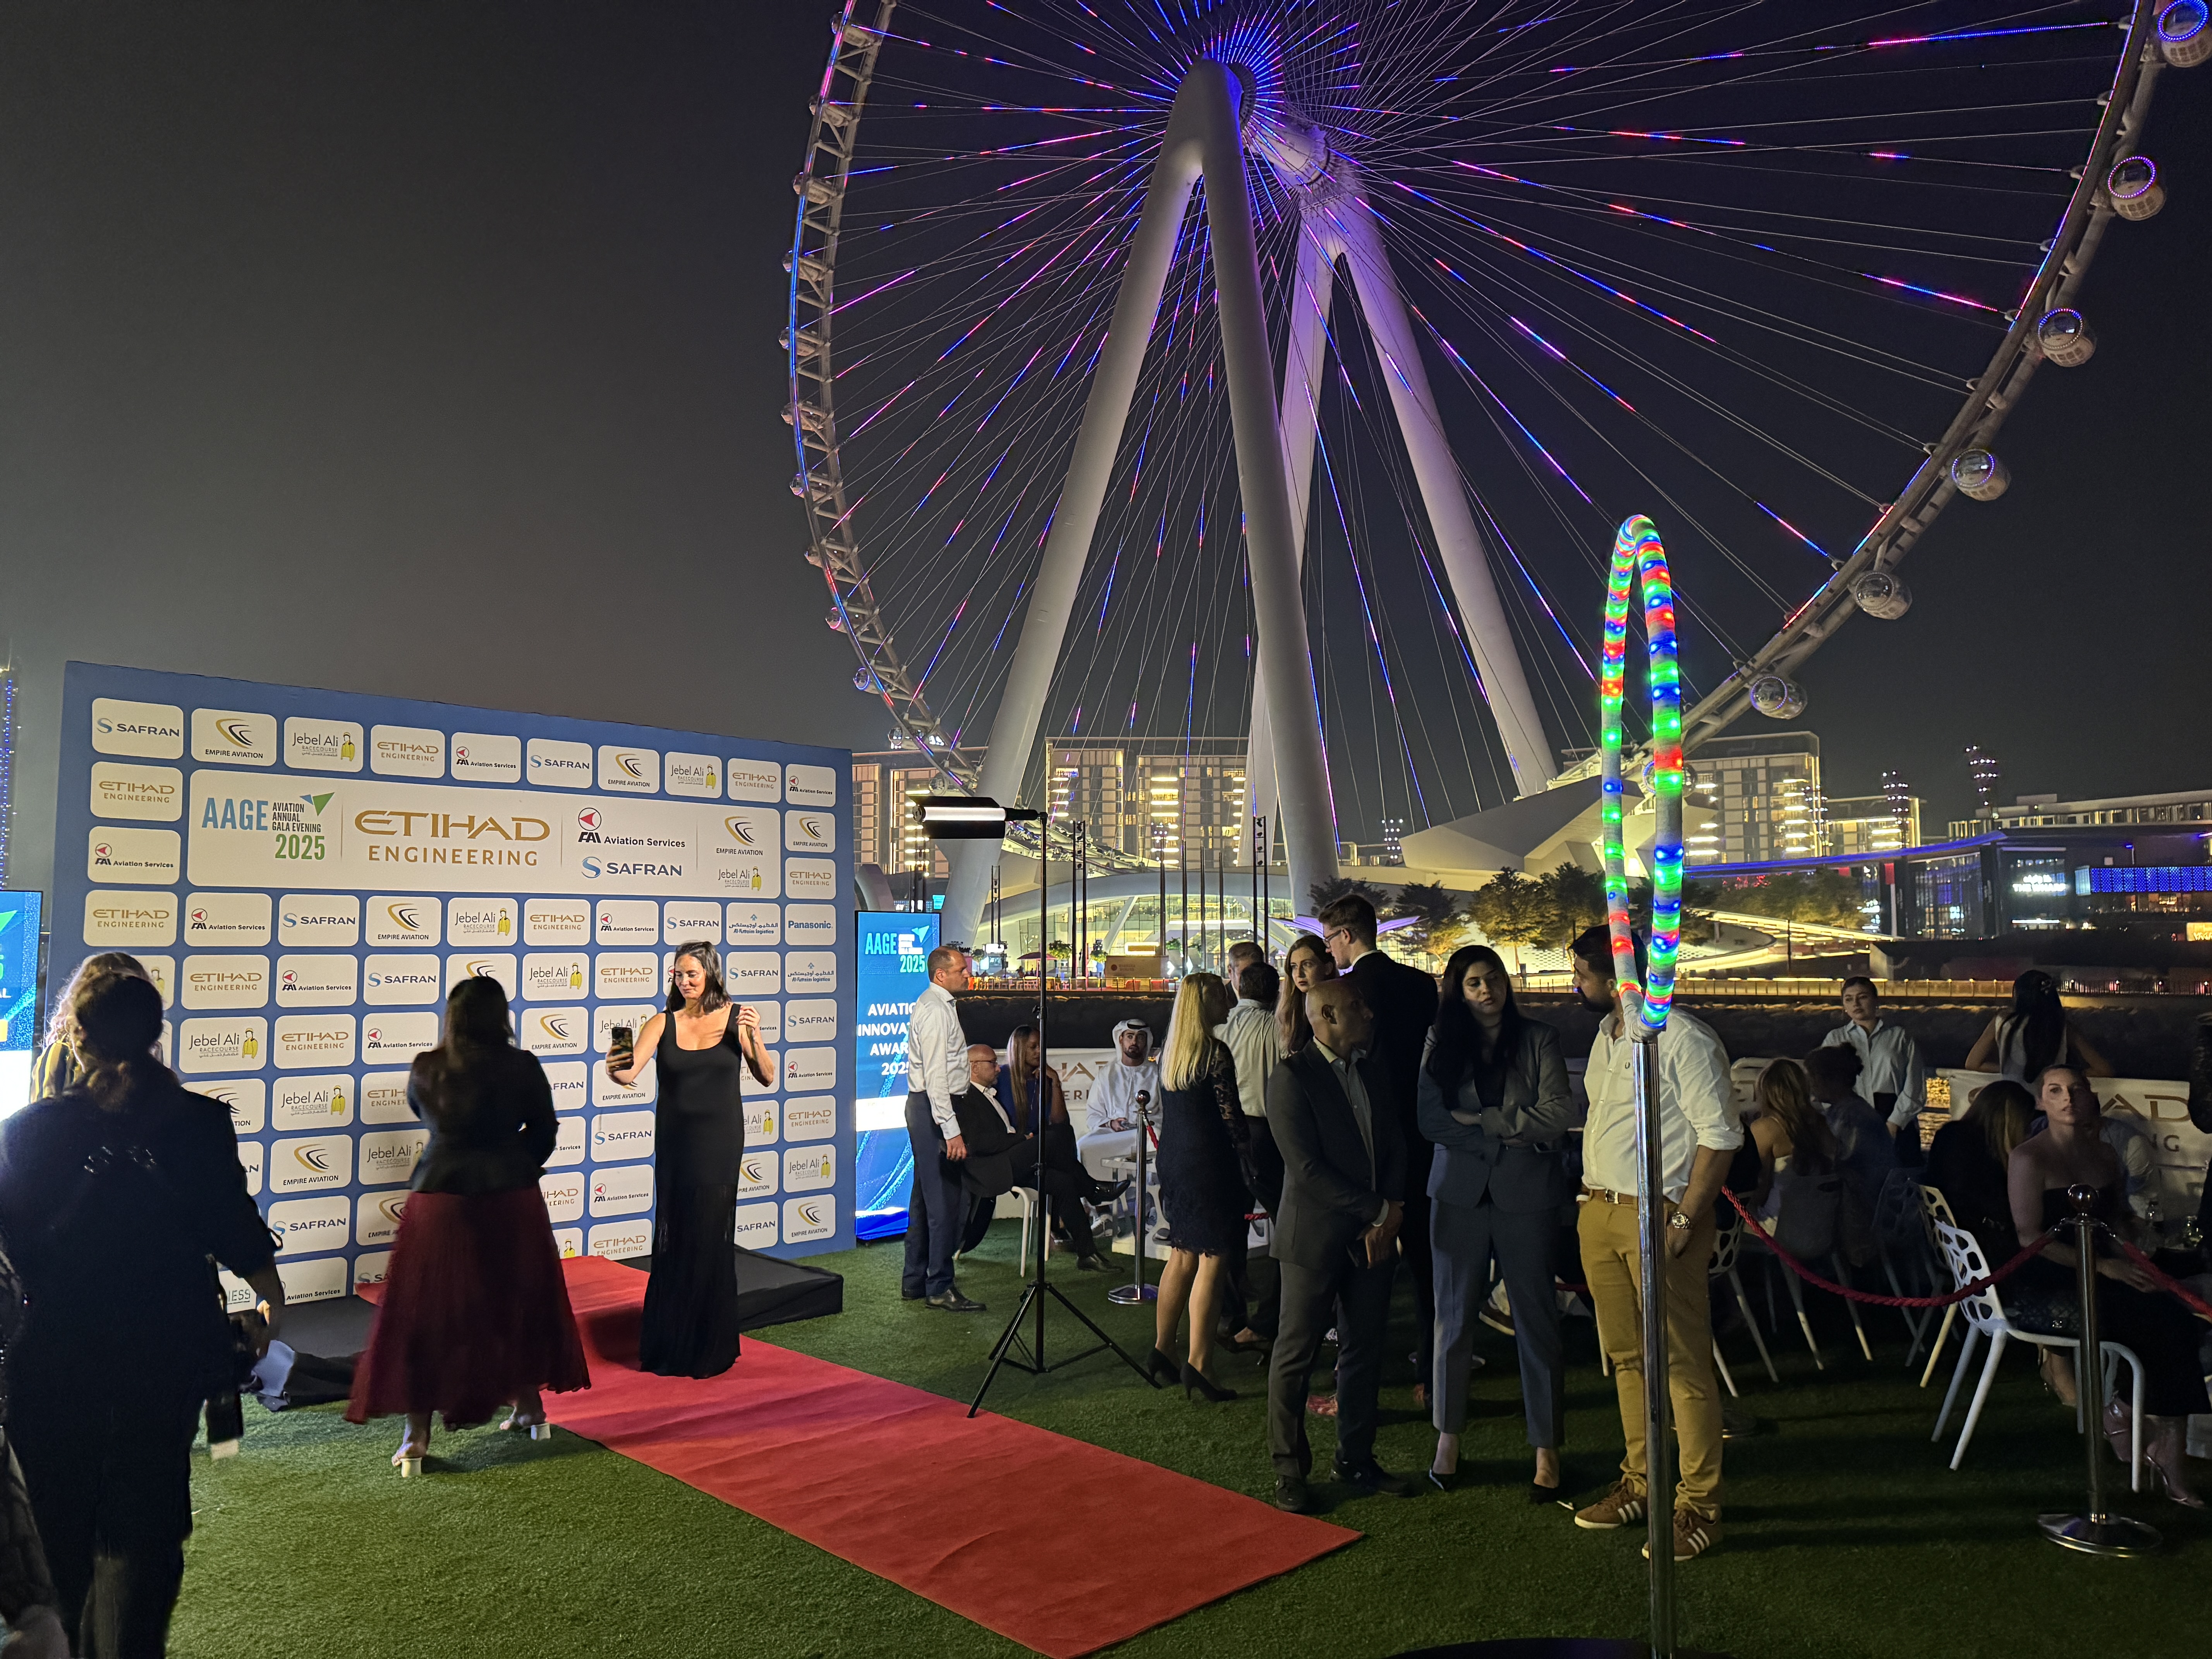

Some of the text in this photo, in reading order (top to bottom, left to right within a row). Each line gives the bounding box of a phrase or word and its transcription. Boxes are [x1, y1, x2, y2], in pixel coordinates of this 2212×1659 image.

[117, 724, 179, 737] SAFRAN
[292, 733, 338, 747] Jebel Ali
[377, 742, 438, 754] ETIHAD
[381, 752, 434, 762] ENGINEERING
[545, 759, 589, 769] SAFRAN
[671, 765, 703, 776] Jebel Ali
[733, 773, 776, 783] ETIHAD
[99, 781, 175, 794] ETIHAD
[104, 793, 169, 803] ENGINEERING
[273, 802, 304, 812] AVIATION
[202, 798, 268, 831] AAGE
[273, 812, 300, 822] ANNUAL
[272, 822, 321, 832] GALA EVENING
[355, 810, 550, 841] ETIHAD
[578, 832, 685, 847] FAI Aviation Services
[275, 834, 325, 860] 2025
[369, 845, 537, 866] ENGINEERING
[607, 863, 681, 876] SAFRAN
[718, 869, 749, 880] Jebel Ali
[93, 910, 169, 919] ETIHAD
[455, 912, 495, 927] Jebel Ali
[865, 933, 897, 955] AAGE
[900, 955, 925, 973] 2025
[190, 973, 262, 982] ETIHAD
[529, 967, 567, 981] Jebel Ali
[868, 1002, 916, 1016] AVIATI
[600, 1018, 636, 1033] Jebel Ali
[858, 1023, 910, 1036] INNOVA
[189, 1033, 239, 1051] Jebel Ali
[282, 1032, 349, 1042] ETIHAD
[870, 1041, 908, 1056] AWAR
[554, 1082, 584, 1090] FRAN
[281, 1091, 328, 1109] Jebel Ali
[368, 1089, 406, 1098] ETIH
[751, 1114, 761, 1124] Ali
[788, 1110, 831, 1120] ETIHAD
[608, 1130, 652, 1140] SAFRAN
[367, 1145, 411, 1163] Jebel Ali
[789, 1160, 819, 1175] Jebel Ali
[544, 1188, 578, 1199] IHAD
[290, 1218, 346, 1231] SAFRAN
[737, 1221, 775, 1232] SAFRAN
[594, 1235, 646, 1248] ETIHAD
